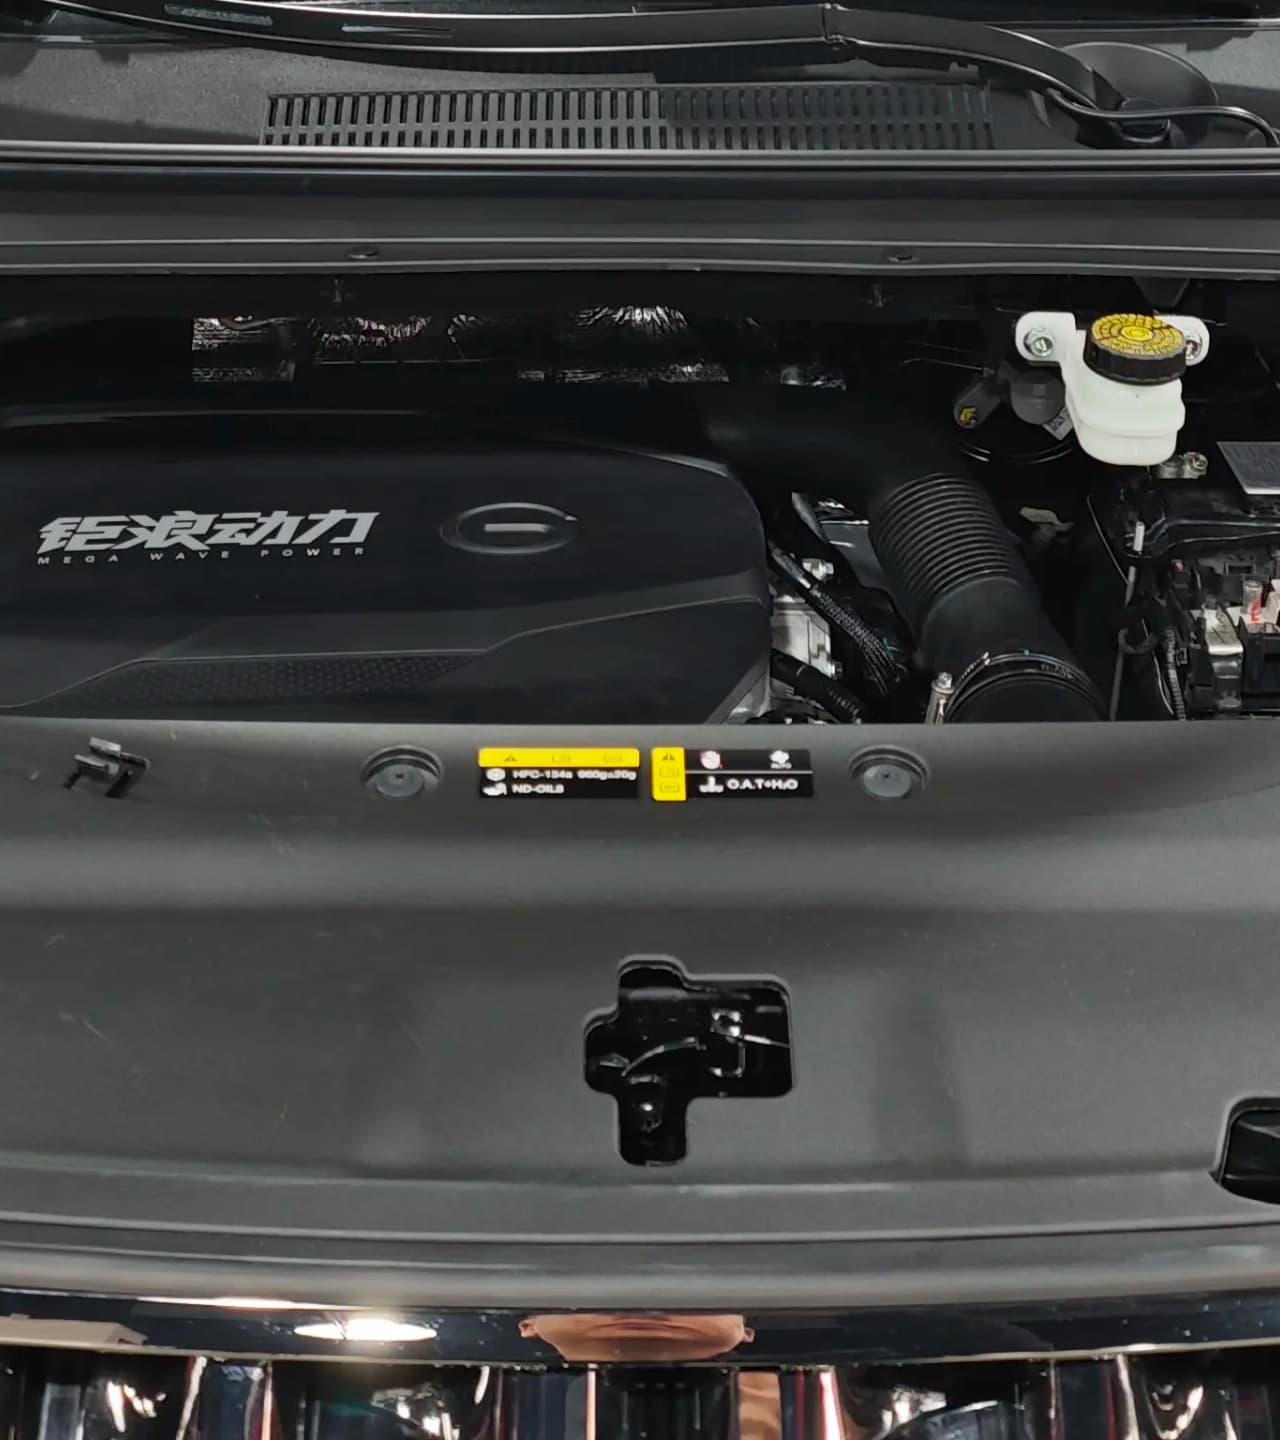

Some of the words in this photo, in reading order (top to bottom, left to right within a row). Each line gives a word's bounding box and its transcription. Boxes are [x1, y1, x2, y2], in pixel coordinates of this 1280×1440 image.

[37, 509, 380, 554] 钜浪动力
[37, 554, 120, 565] MEGA
[150, 550, 231, 561] WAVE
[259, 546, 366, 558] POWER
